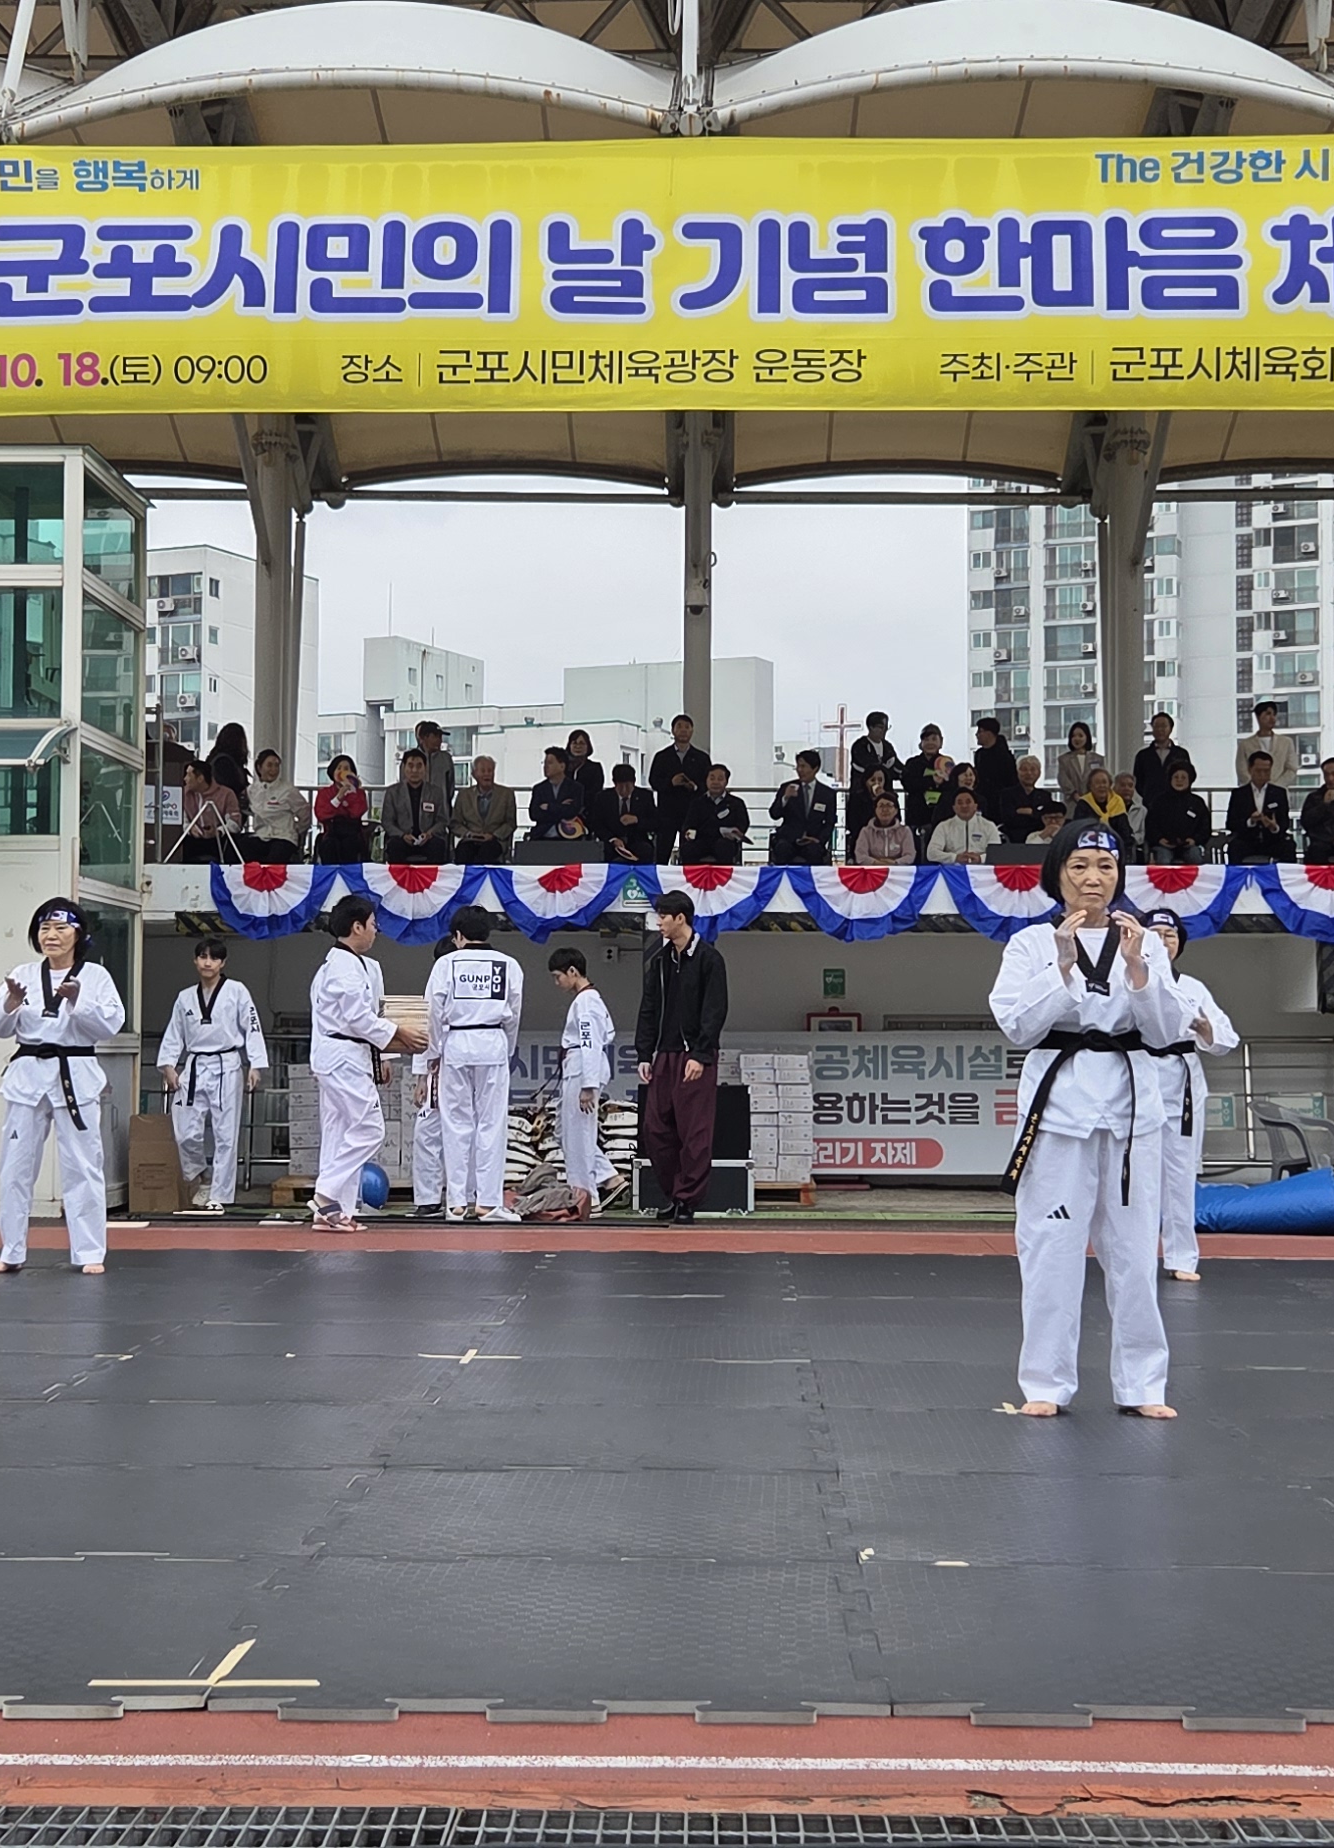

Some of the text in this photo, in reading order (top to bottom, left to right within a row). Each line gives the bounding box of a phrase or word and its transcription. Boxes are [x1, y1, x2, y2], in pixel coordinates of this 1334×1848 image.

[72, 159, 201, 193] 행복하게
[1095, 153, 1161, 184] The
[1170, 147, 1286, 185] 건강한
[546, 216, 657, 315] 날
[678, 216, 889, 315] 기념
[918, 215, 1245, 315] 한마음
[173, 354, 268, 385] 09:00
[340, 348, 867, 386] 장소 군포시민체육광장 운동장
[938, 351, 1078, 383] 주최·주관
[492, 966, 501, 993] YOU
[581, 1021, 592, 1049] 군포시
[870, 1142, 917, 1166] 자제
